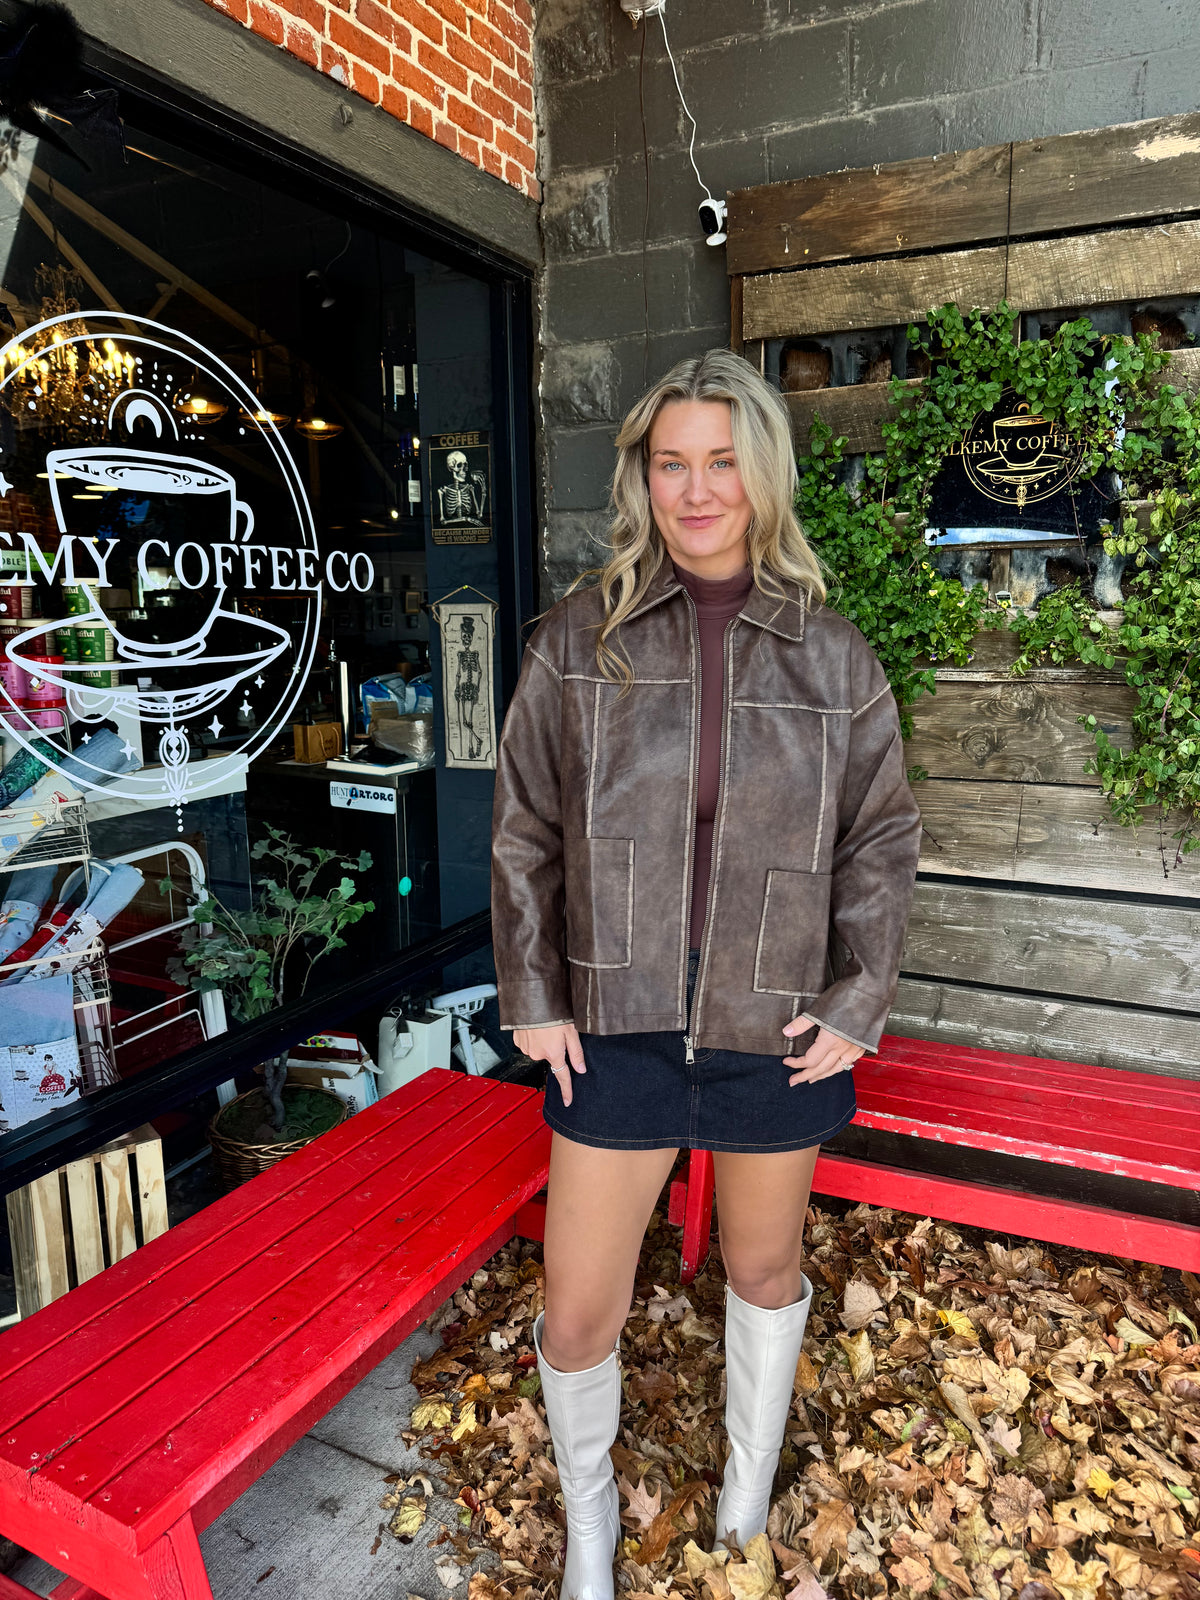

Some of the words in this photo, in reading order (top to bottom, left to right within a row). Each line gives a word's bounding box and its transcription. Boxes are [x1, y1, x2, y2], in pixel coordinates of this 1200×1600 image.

[440, 434, 480, 447] COFFEE
[948, 437, 1012, 456] LKEMY
[137, 539, 323, 591] COFFEE
[325, 550, 375, 592] CO
